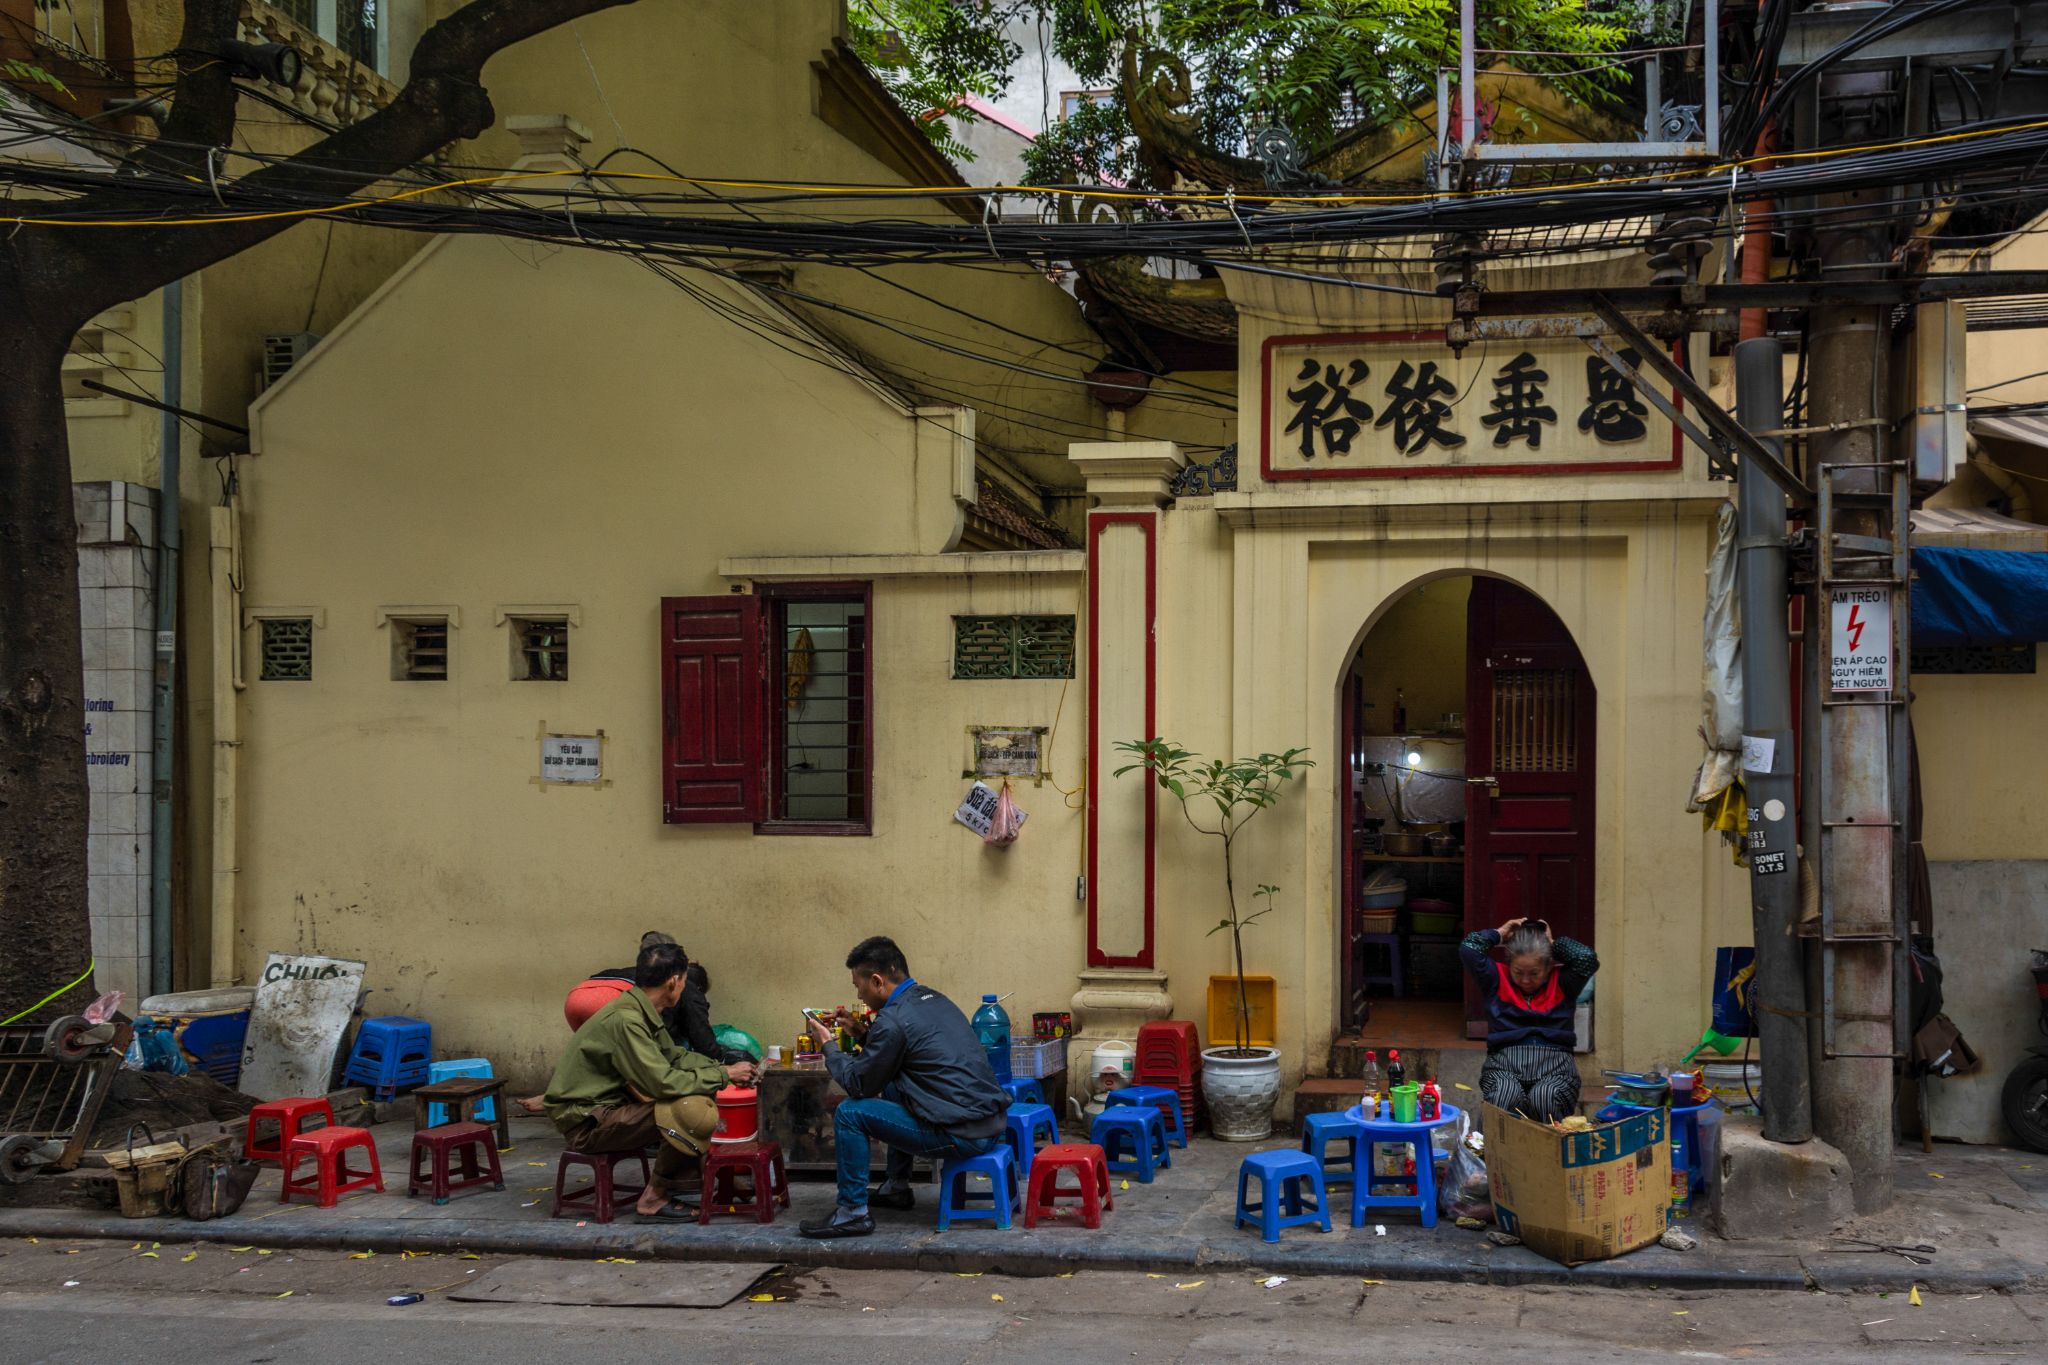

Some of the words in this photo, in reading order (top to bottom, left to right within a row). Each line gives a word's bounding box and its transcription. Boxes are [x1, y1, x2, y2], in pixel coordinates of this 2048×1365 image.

[1849, 655, 1863, 665] ÁP
[1865, 656, 1887, 664] CAO
[1831, 678, 1851, 688] HẾT
[85, 698, 114, 712] loring
[86, 752, 130, 766] broidery
[1755, 852, 1785, 864] SONET
[1758, 862, 1784, 873] O.T.S
